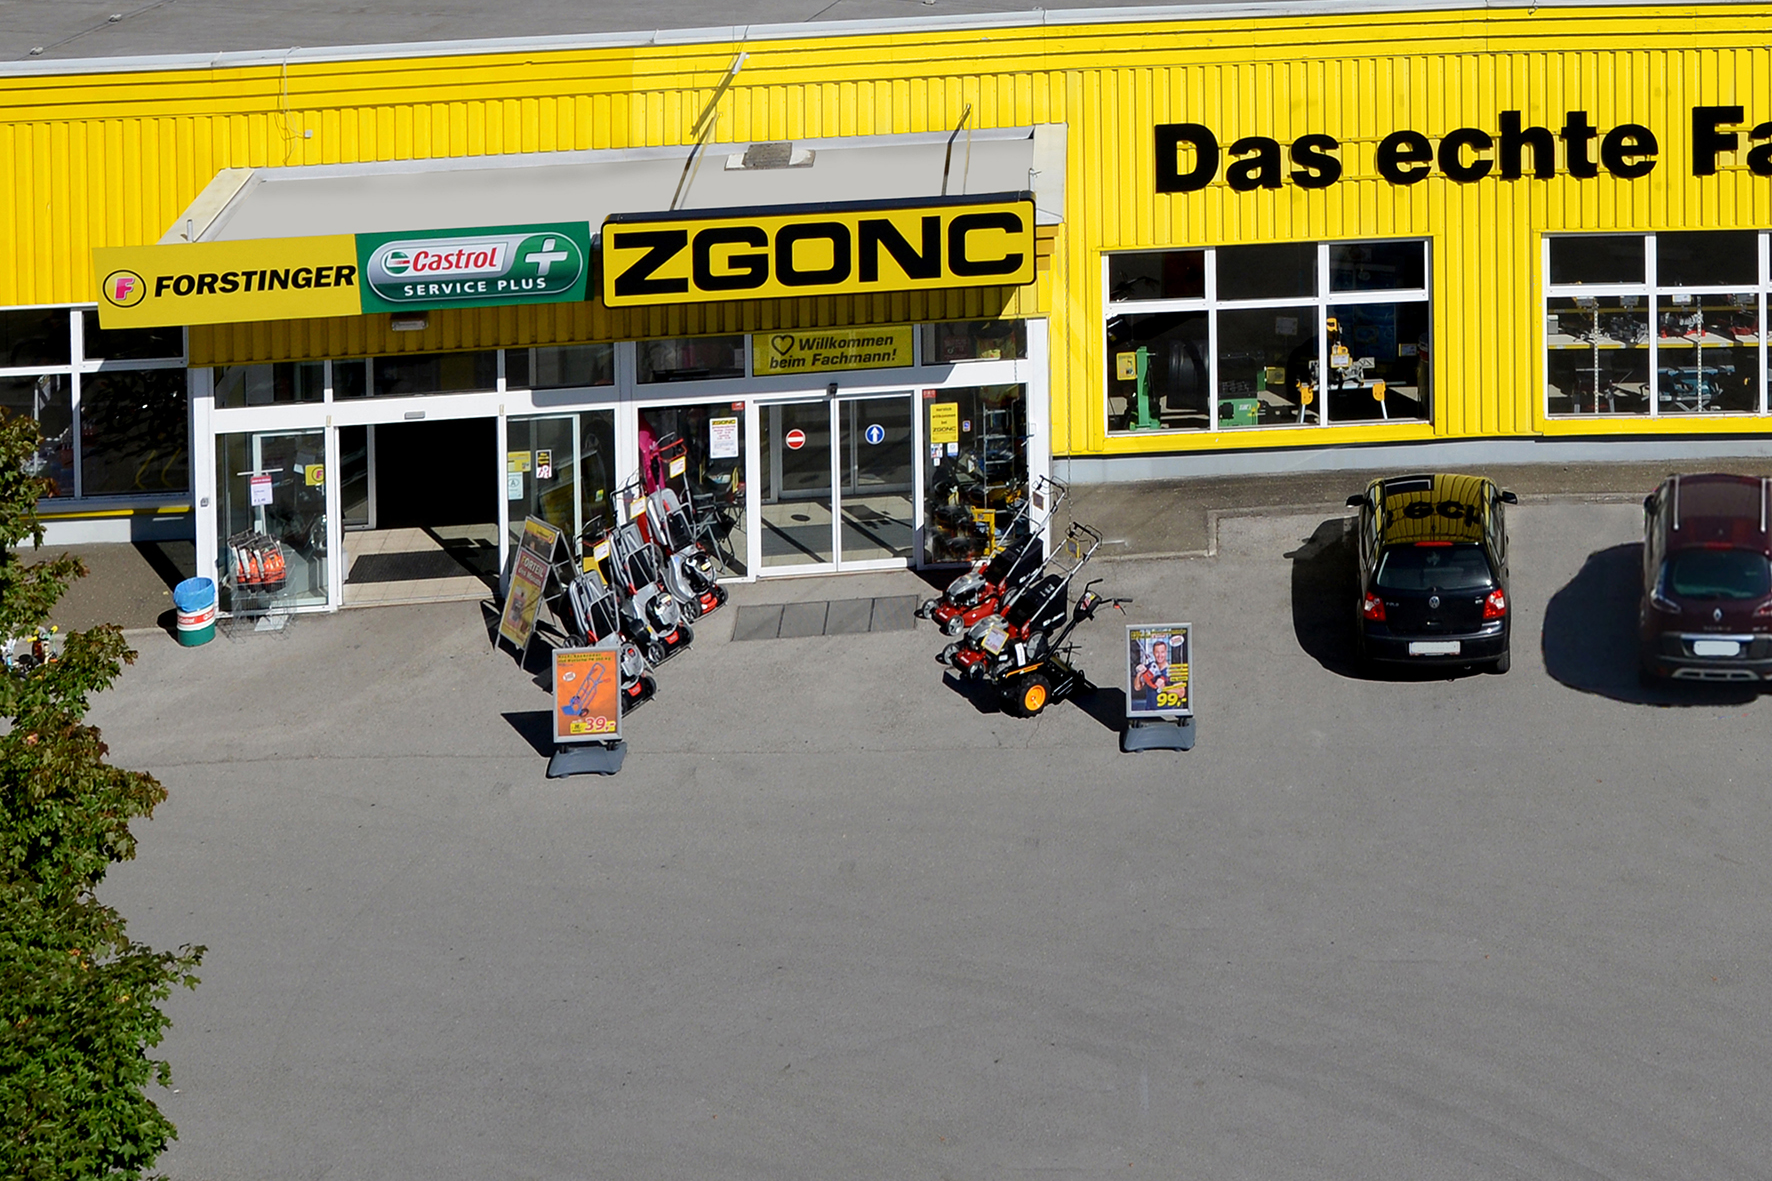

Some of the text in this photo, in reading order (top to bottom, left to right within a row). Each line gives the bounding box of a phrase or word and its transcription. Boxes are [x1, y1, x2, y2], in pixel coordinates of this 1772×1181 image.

[1155, 124, 1342, 192] Das
[1378, 111, 1658, 184] echte
[412, 247, 497, 272] Castrol
[613, 211, 1024, 297] ZGONC
[154, 265, 356, 297] FORSTINGER
[404, 277, 547, 296] SERVICE PLUS
[799, 334, 894, 351] Willkommen
[769, 349, 897, 369] beim Fachmann!
[1156, 692, 1187, 707] 99,-
[584, 716, 616, 732] 39,-
